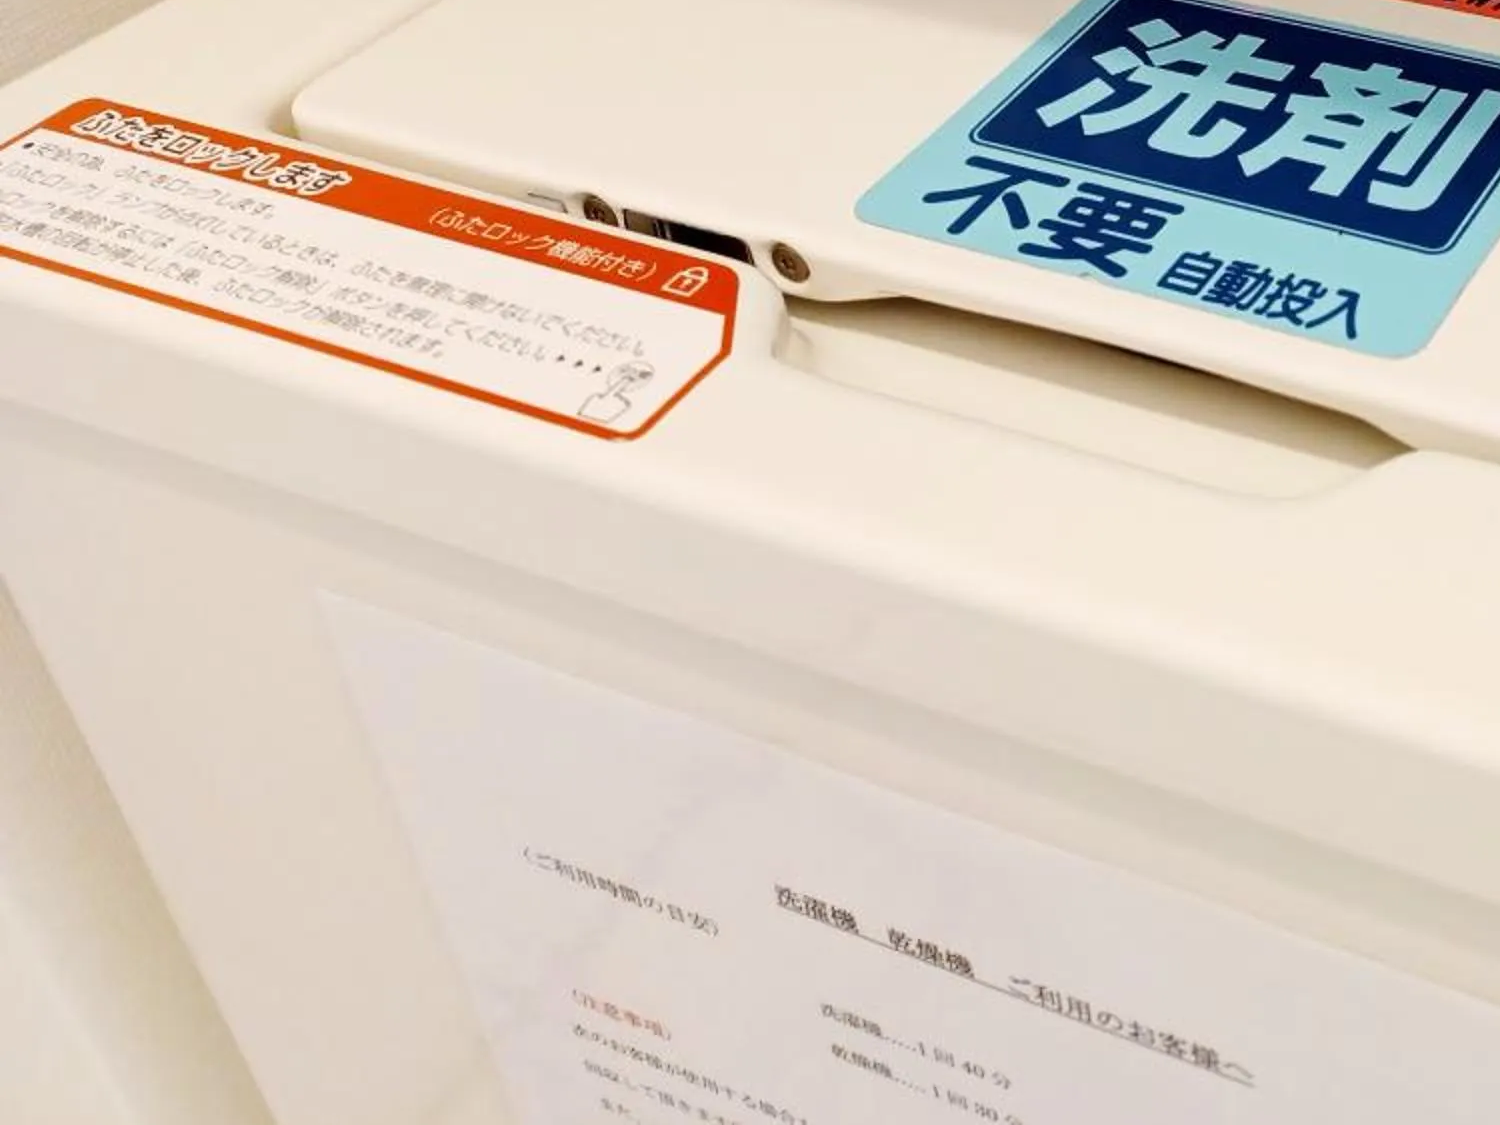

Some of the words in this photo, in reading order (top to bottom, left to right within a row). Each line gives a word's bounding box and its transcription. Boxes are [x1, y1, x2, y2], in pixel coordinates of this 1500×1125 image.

[74, 110, 351, 193] ふたをロックします
[921, 155, 1186, 278] 不要
[1155, 250, 1360, 341] 自動投入
